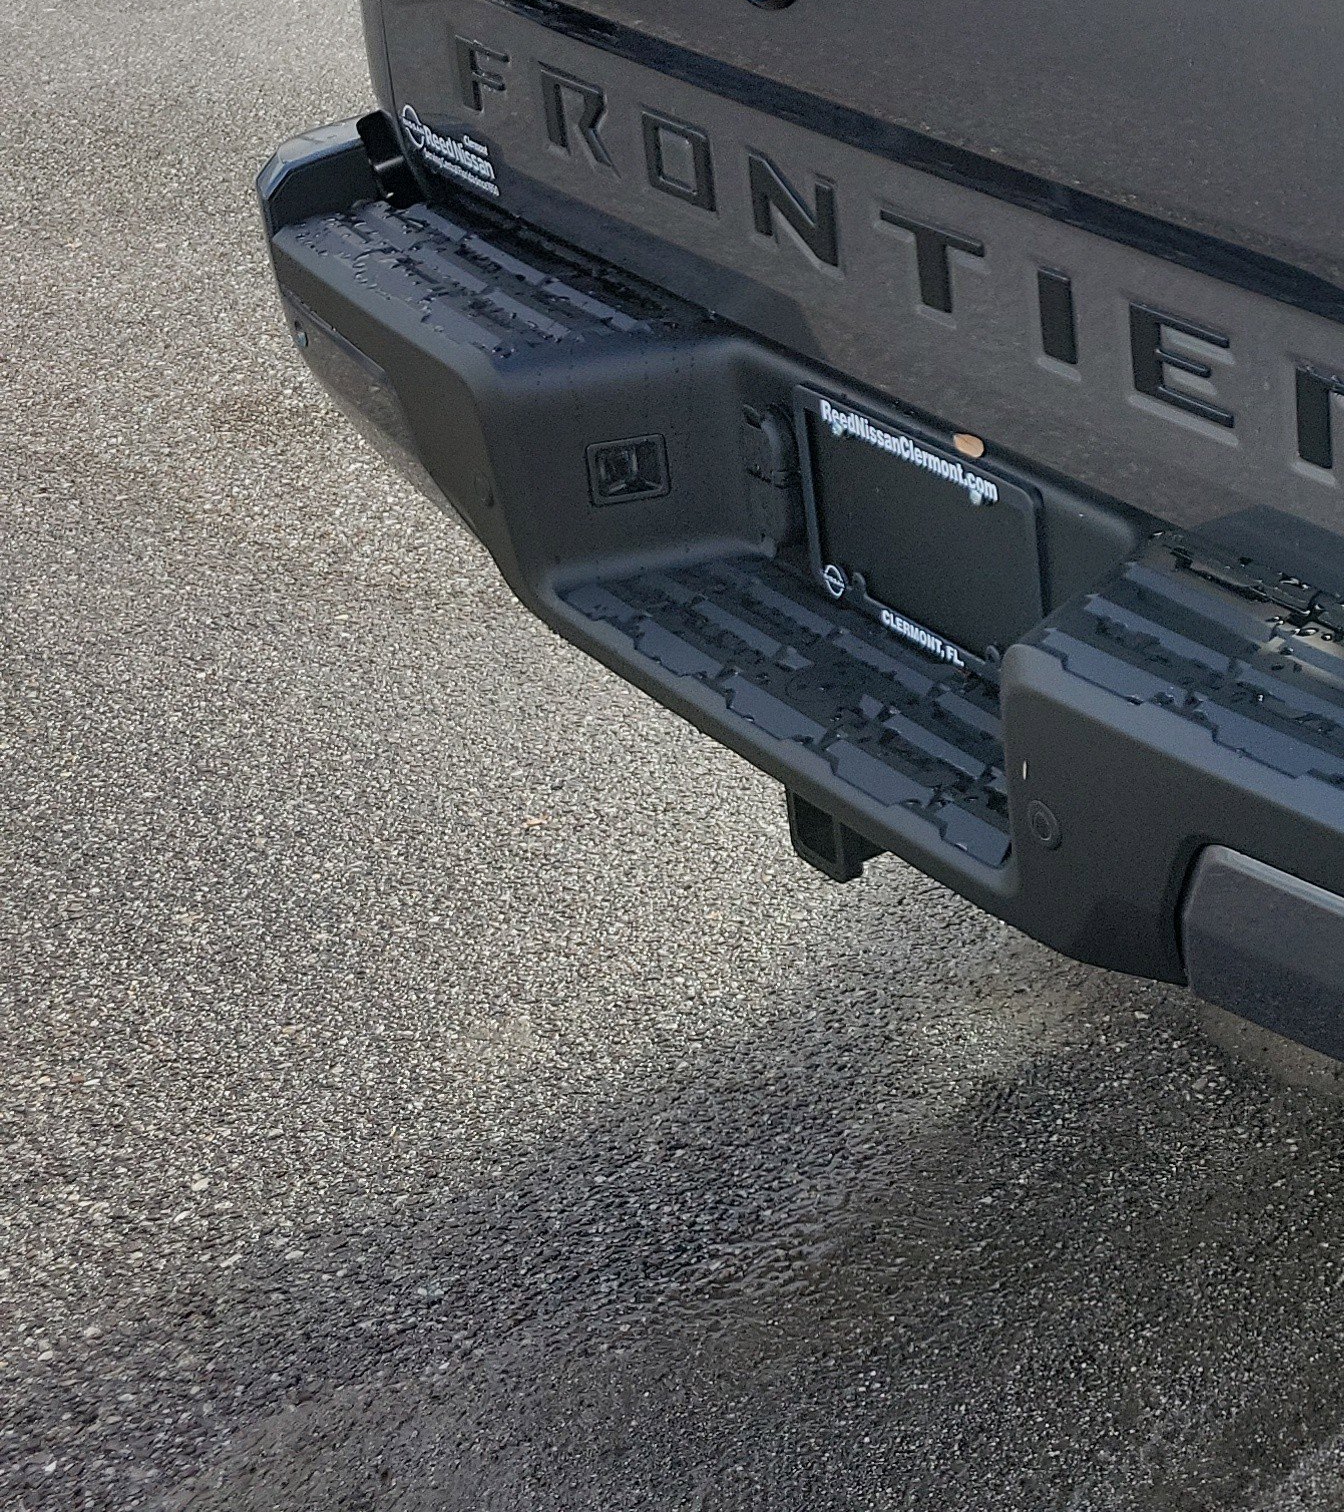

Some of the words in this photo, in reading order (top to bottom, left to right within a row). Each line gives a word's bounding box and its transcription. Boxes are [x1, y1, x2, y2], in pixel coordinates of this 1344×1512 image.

[422, 124, 496, 180] ReedNissan
[819, 398, 999, 503] ReedNissanClermont.com
[880, 609, 945, 658] CLERMONT,
